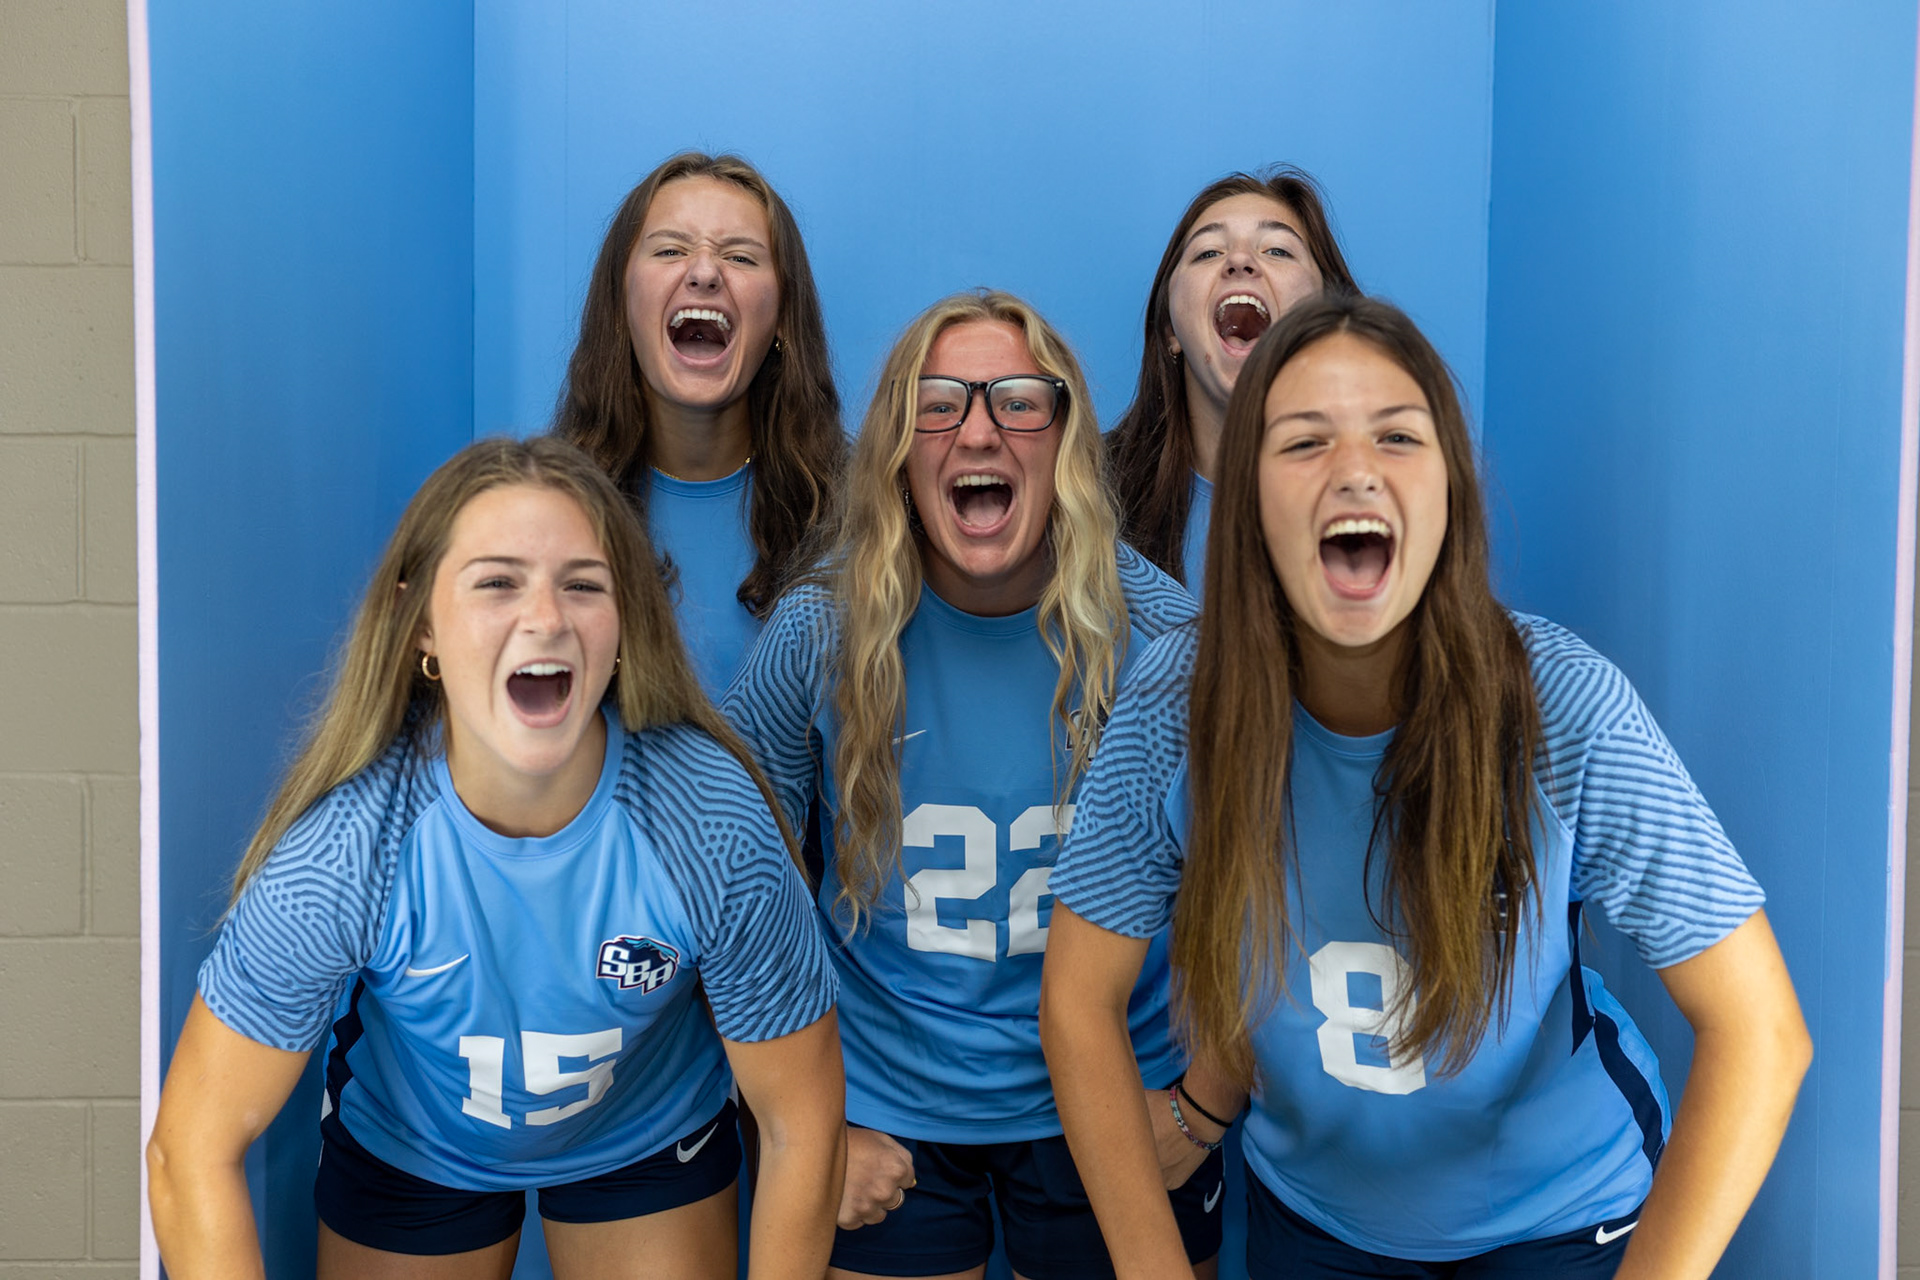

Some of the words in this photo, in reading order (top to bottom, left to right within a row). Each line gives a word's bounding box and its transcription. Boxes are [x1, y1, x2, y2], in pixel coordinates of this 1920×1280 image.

[903, 803, 1076, 962] 22
[601, 945, 674, 991] SBA
[1309, 941, 1427, 1095] 8
[459, 1027, 623, 1130] 15
